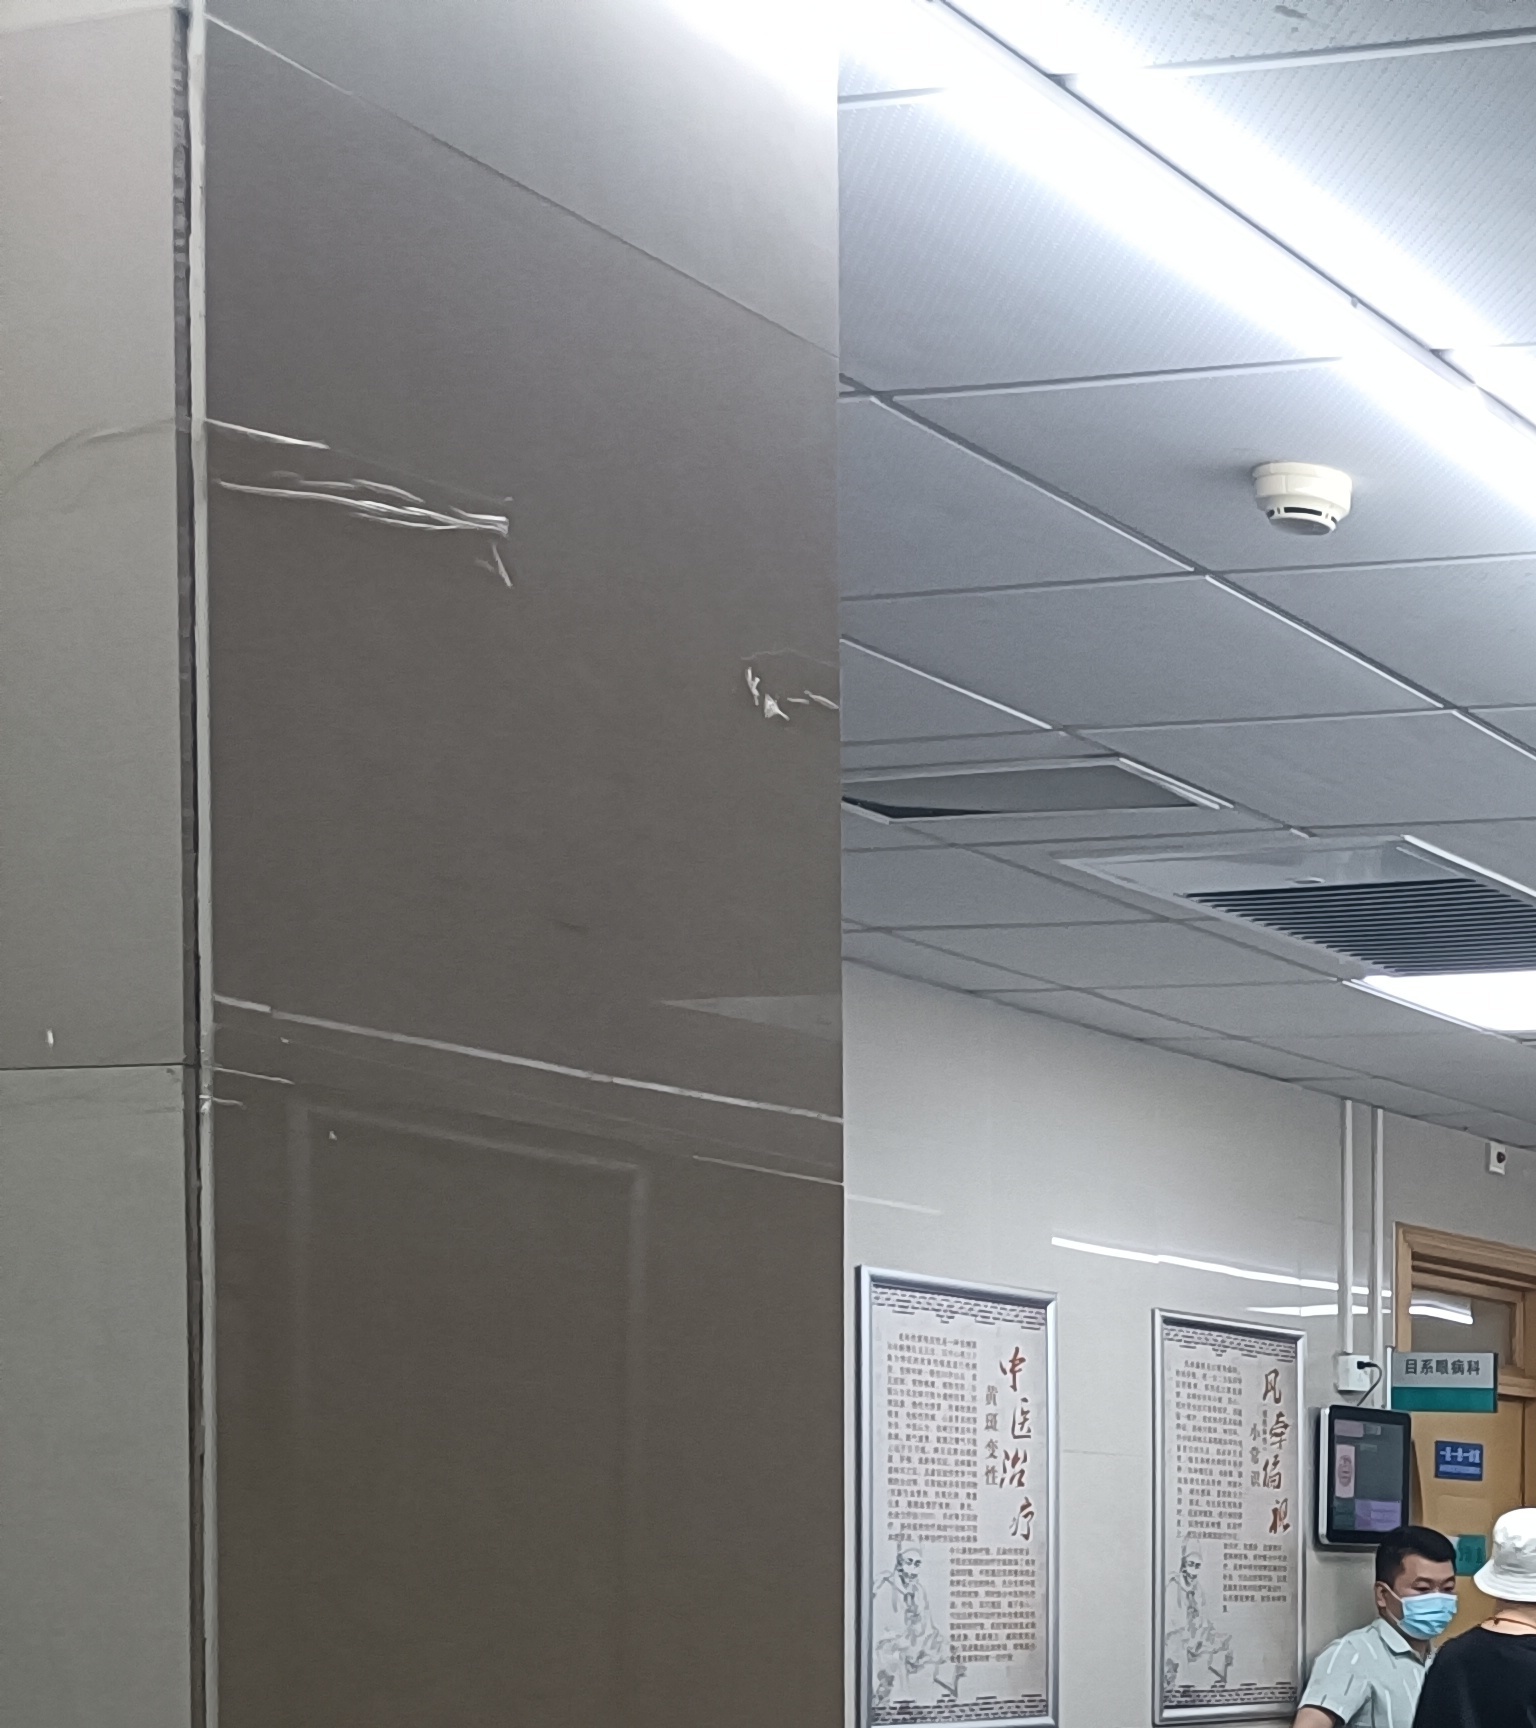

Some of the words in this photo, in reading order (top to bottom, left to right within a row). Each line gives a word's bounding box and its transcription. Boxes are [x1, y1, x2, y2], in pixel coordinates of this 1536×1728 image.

[1404, 1358, 1481, 1376] 目系眼病科
[984, 1384, 999, 1486] 黄斑变性
[1000, 1346, 1035, 1541] 中医治疗
